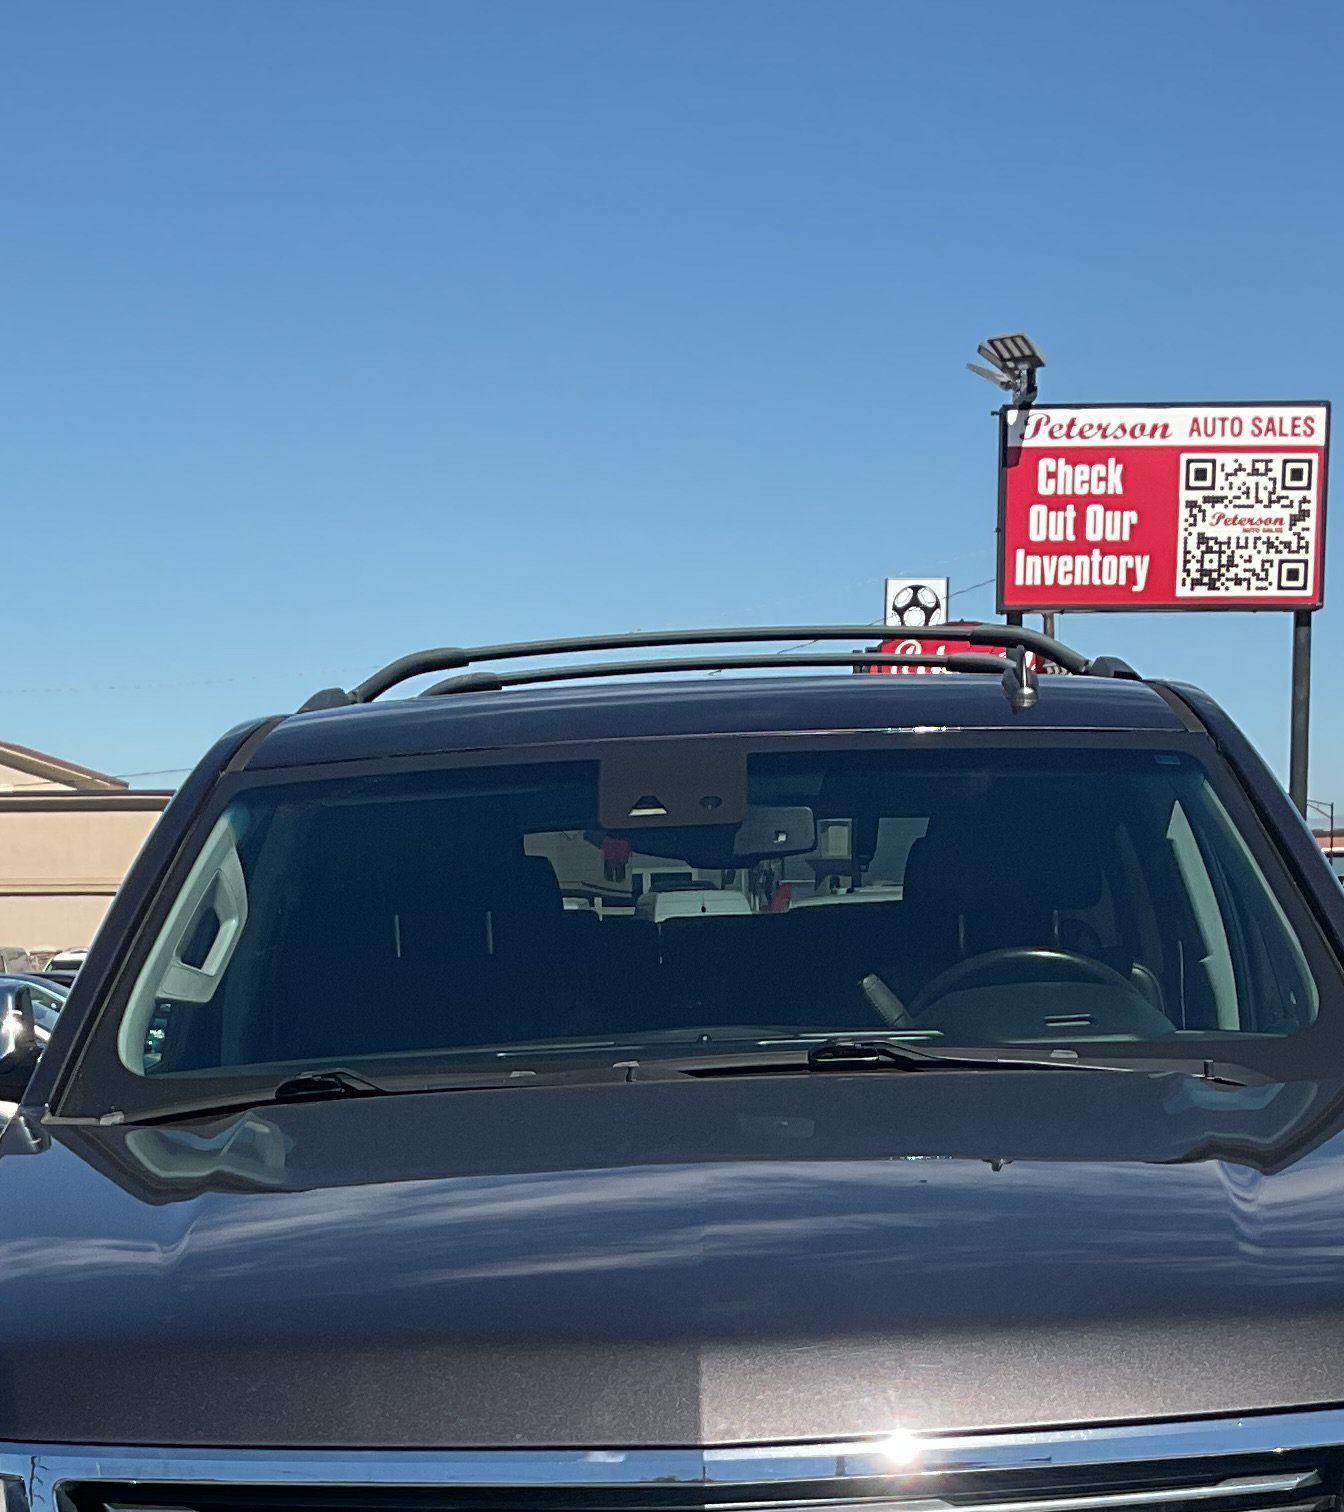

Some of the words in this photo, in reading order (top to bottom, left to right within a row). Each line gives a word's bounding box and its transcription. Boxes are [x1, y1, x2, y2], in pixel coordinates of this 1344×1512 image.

[1018, 412, 1173, 441] Peterson
[1188, 416, 1243, 438] AUTO
[1250, 414, 1315, 438] SALES
[1037, 457, 1123, 496] Check
[1029, 504, 1079, 543] Out
[1085, 504, 1138, 542] Our
[1209, 512, 1285, 527] Peterson
[1014, 548, 1150, 592] Inventory
